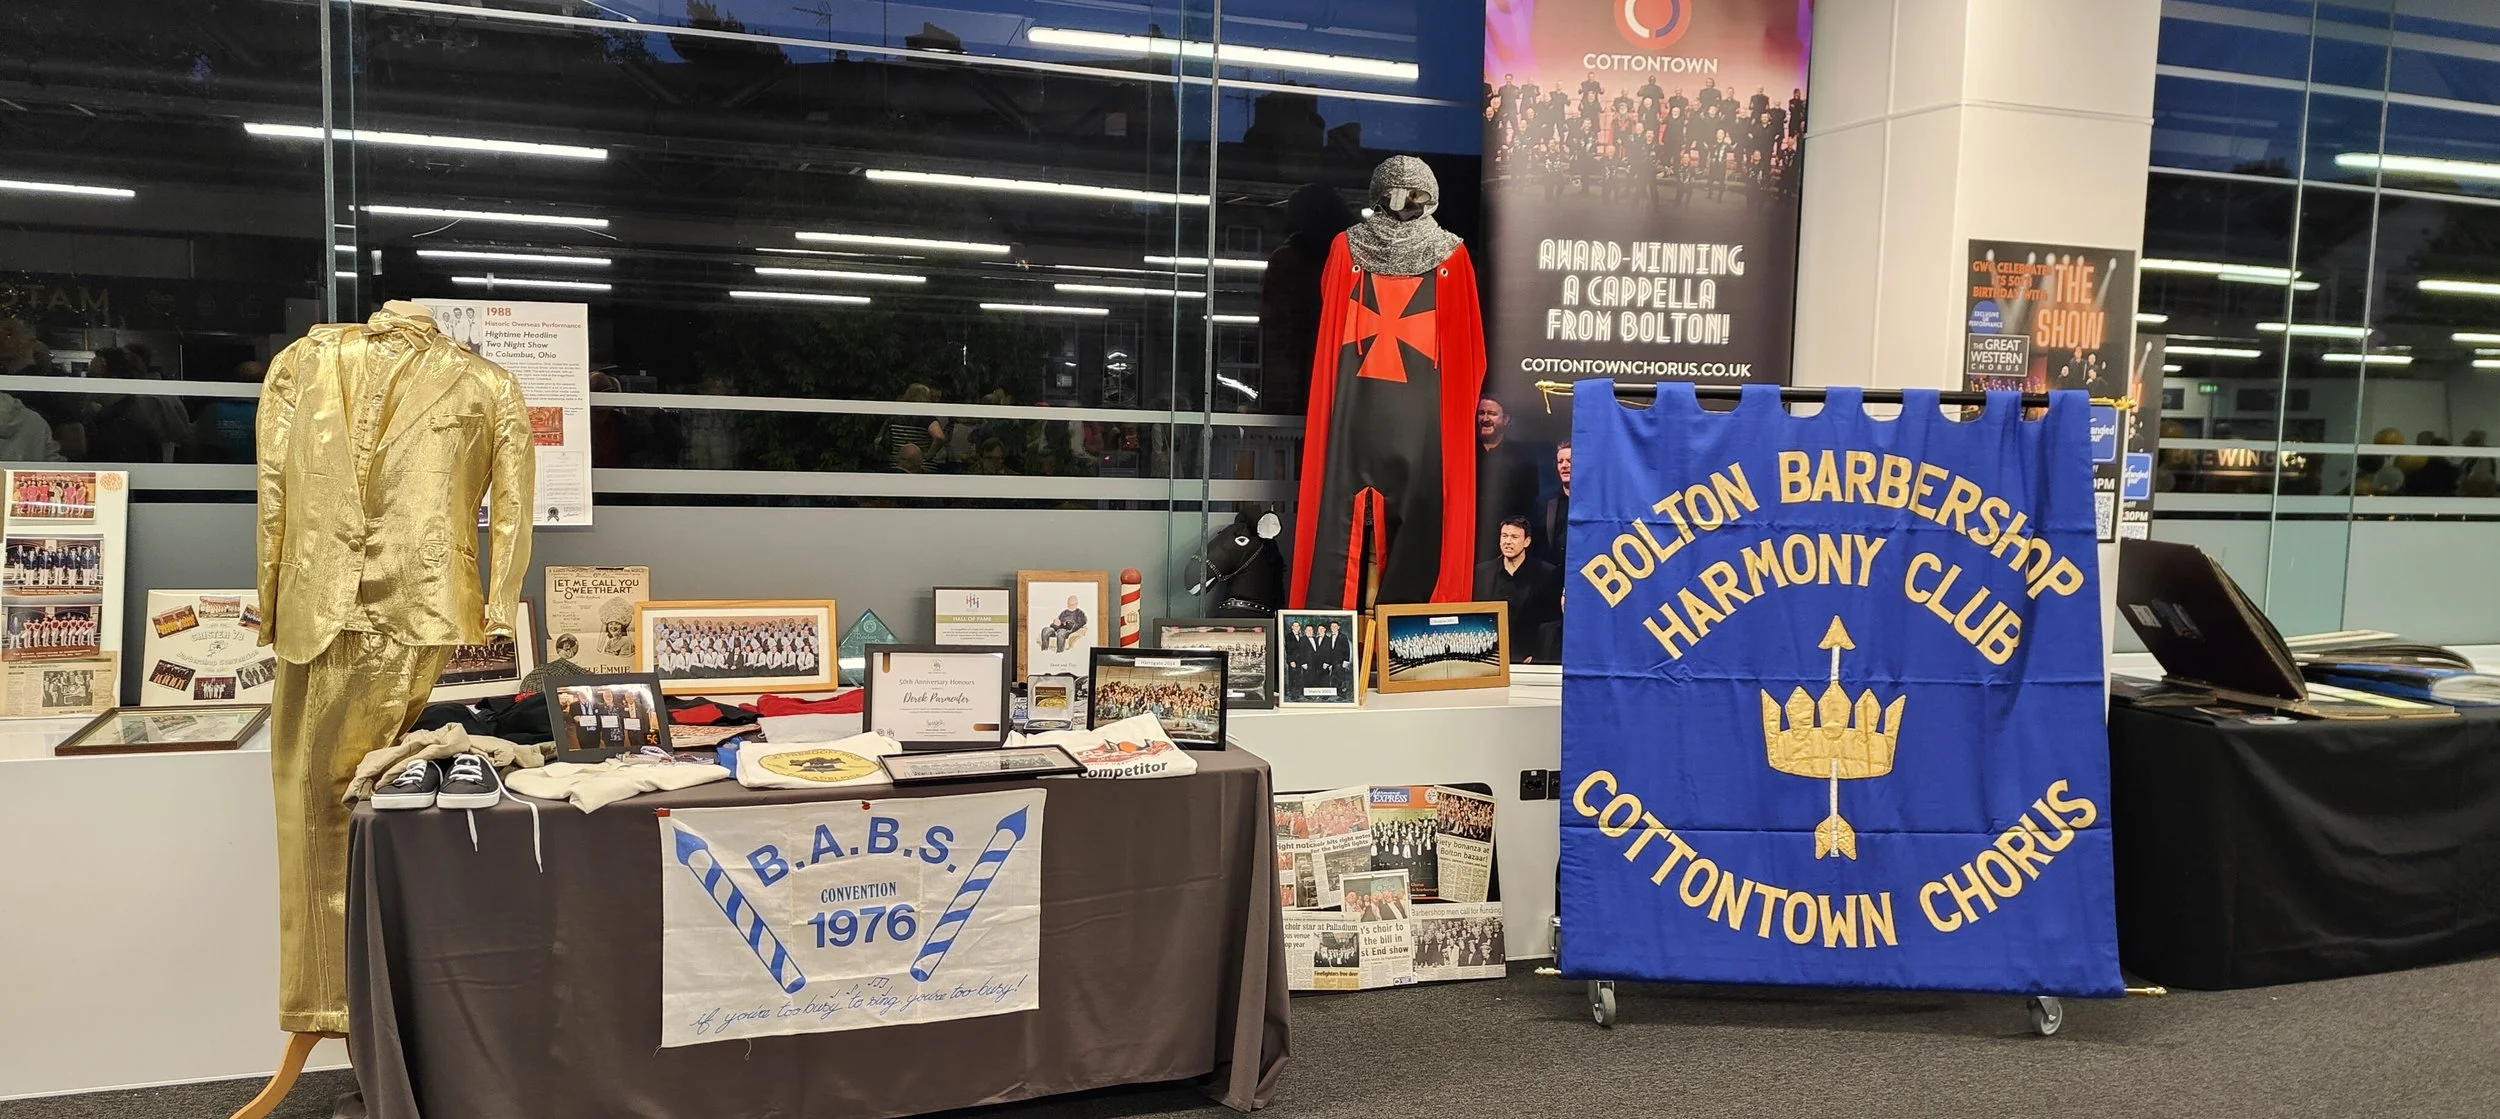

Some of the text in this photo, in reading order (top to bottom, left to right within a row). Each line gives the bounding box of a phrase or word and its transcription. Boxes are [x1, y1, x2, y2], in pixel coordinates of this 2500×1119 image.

[1583, 52, 1718, 74] COTTONTOWN
[1539, 238, 1745, 276] AWARD-WINNING
[2055, 264, 2095, 305] THE
[1563, 275, 1716, 310] A CAPPELLA
[1972, 287, 2020, 299] BIRTHDAY
[487, 307, 512, 317] 1988
[1546, 309, 1731, 345] FROM BOLTON!
[2036, 308, 2105, 350] SHOW
[485, 331, 558, 340] Hightime Headline
[486, 340, 549, 349] Two Night Show
[1973, 338, 2022, 351] THE GREAT
[495, 350, 536, 360] Columbus,
[538, 351, 557, 359] Ohio
[1970, 351, 2023, 364] WESTERN
[1521, 358, 1752, 377] COTTONTOWNCHORUS.CO.UK
[1971, 363, 2020, 372] CHORUS
[1580, 449, 2085, 608] BOLTON BARBERSHOP
[554, 579, 640, 592] LET ME CALL YOU
[1642, 533, 2025, 666] HARMONY CLUB
[914, 679, 948, 687] Anniversary
[903, 692, 928, 704] Derek
[1373, 793, 1409, 803] EXPRESS
[746, 816, 957, 887] B.A.B.S.
[1440, 847, 1462, 858] Bolton
[1453, 841, 1482, 853] bonanza
[1572, 769, 2099, 949] COTTONTOWN CHORUS
[820, 881, 897, 904] CONVENTION
[1460, 907, 1470, 915] call
[807, 903, 916, 949] 1976
[1303, 923, 1316, 931] star
[1373, 924, 1393, 933] choir
[1395, 923, 1404, 931] to
[1364, 934, 1403, 946] the bill in
[1372, 947, 1387, 956] End
[1389, 946, 1409, 955] show
[777, 1001, 801, 1018] too
